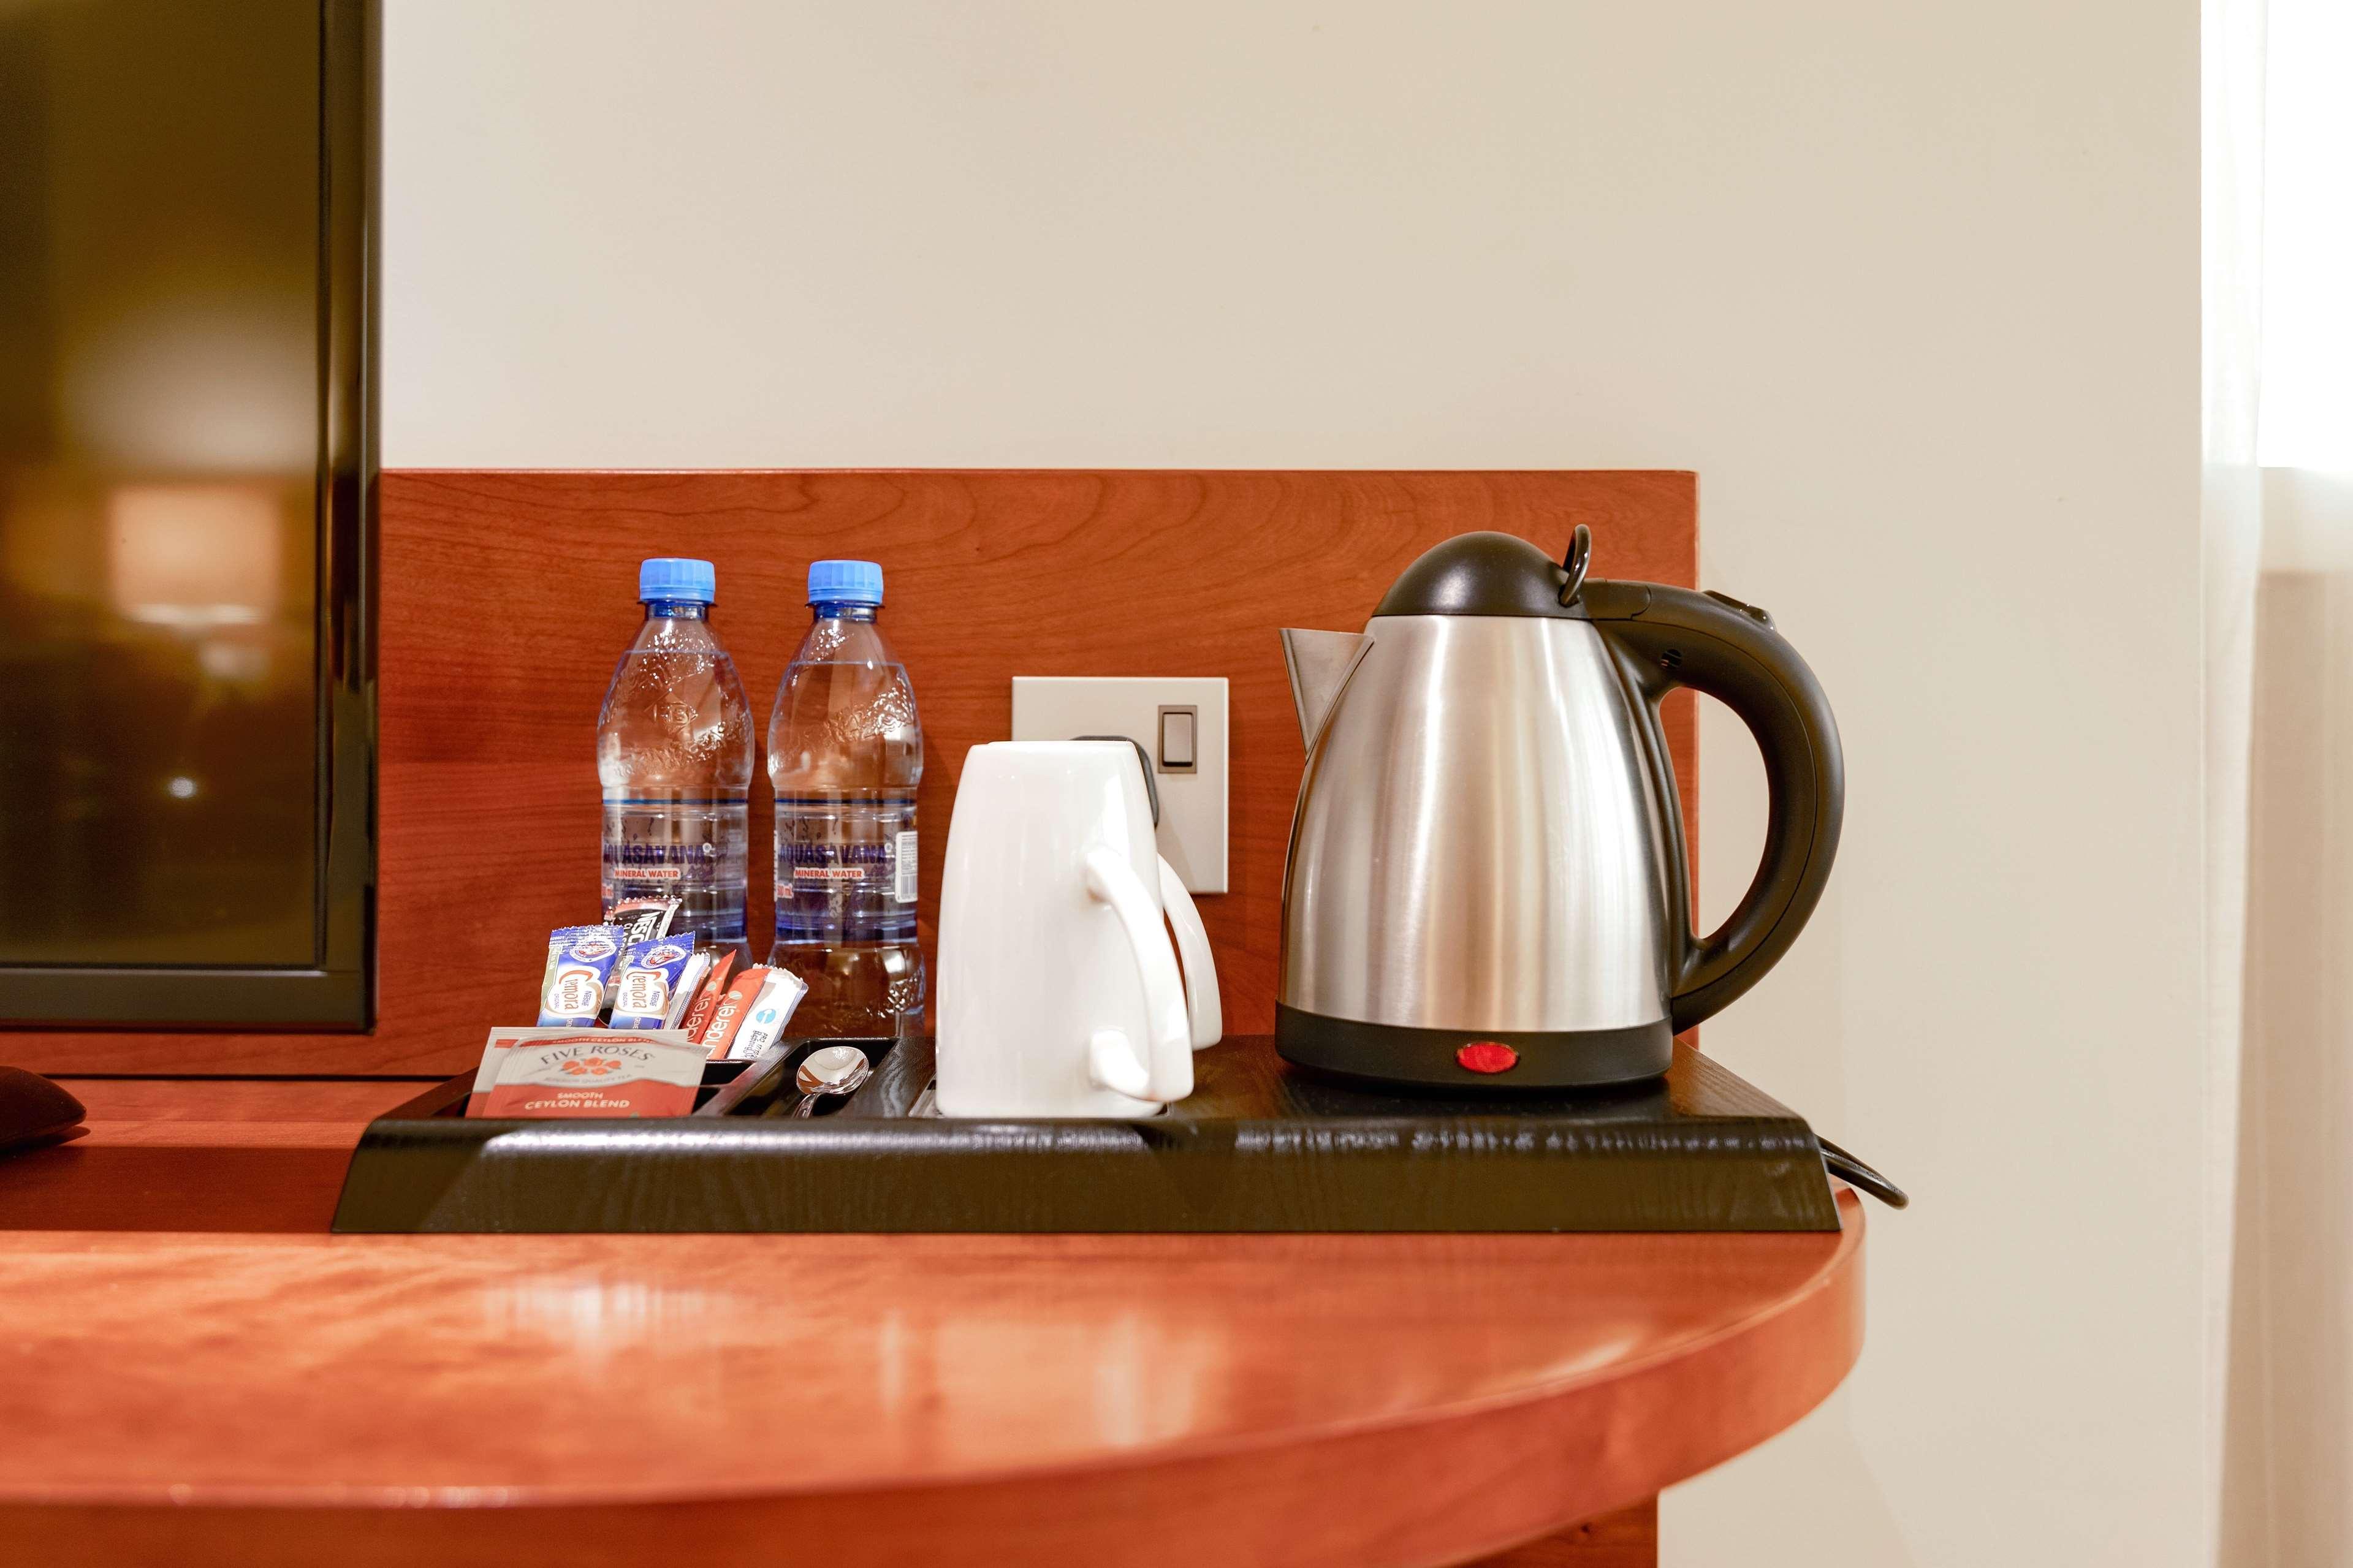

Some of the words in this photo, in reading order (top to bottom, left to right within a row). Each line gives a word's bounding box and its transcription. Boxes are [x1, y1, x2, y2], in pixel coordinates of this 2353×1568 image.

[615, 869, 645, 878] MINERAL
[648, 869, 679, 878] WATER
[794, 869, 829, 878] MINERAL
[832, 869, 862, 878] WATER
[558, 969, 594, 1010] Cremora
[626, 971, 661, 1009] Cremora
[541, 1045, 583, 1065] FIVE
[590, 1045, 652, 1061] ROSES
[525, 1099, 580, 1110] CEYLON
[583, 1099, 630, 1108] BLEND
